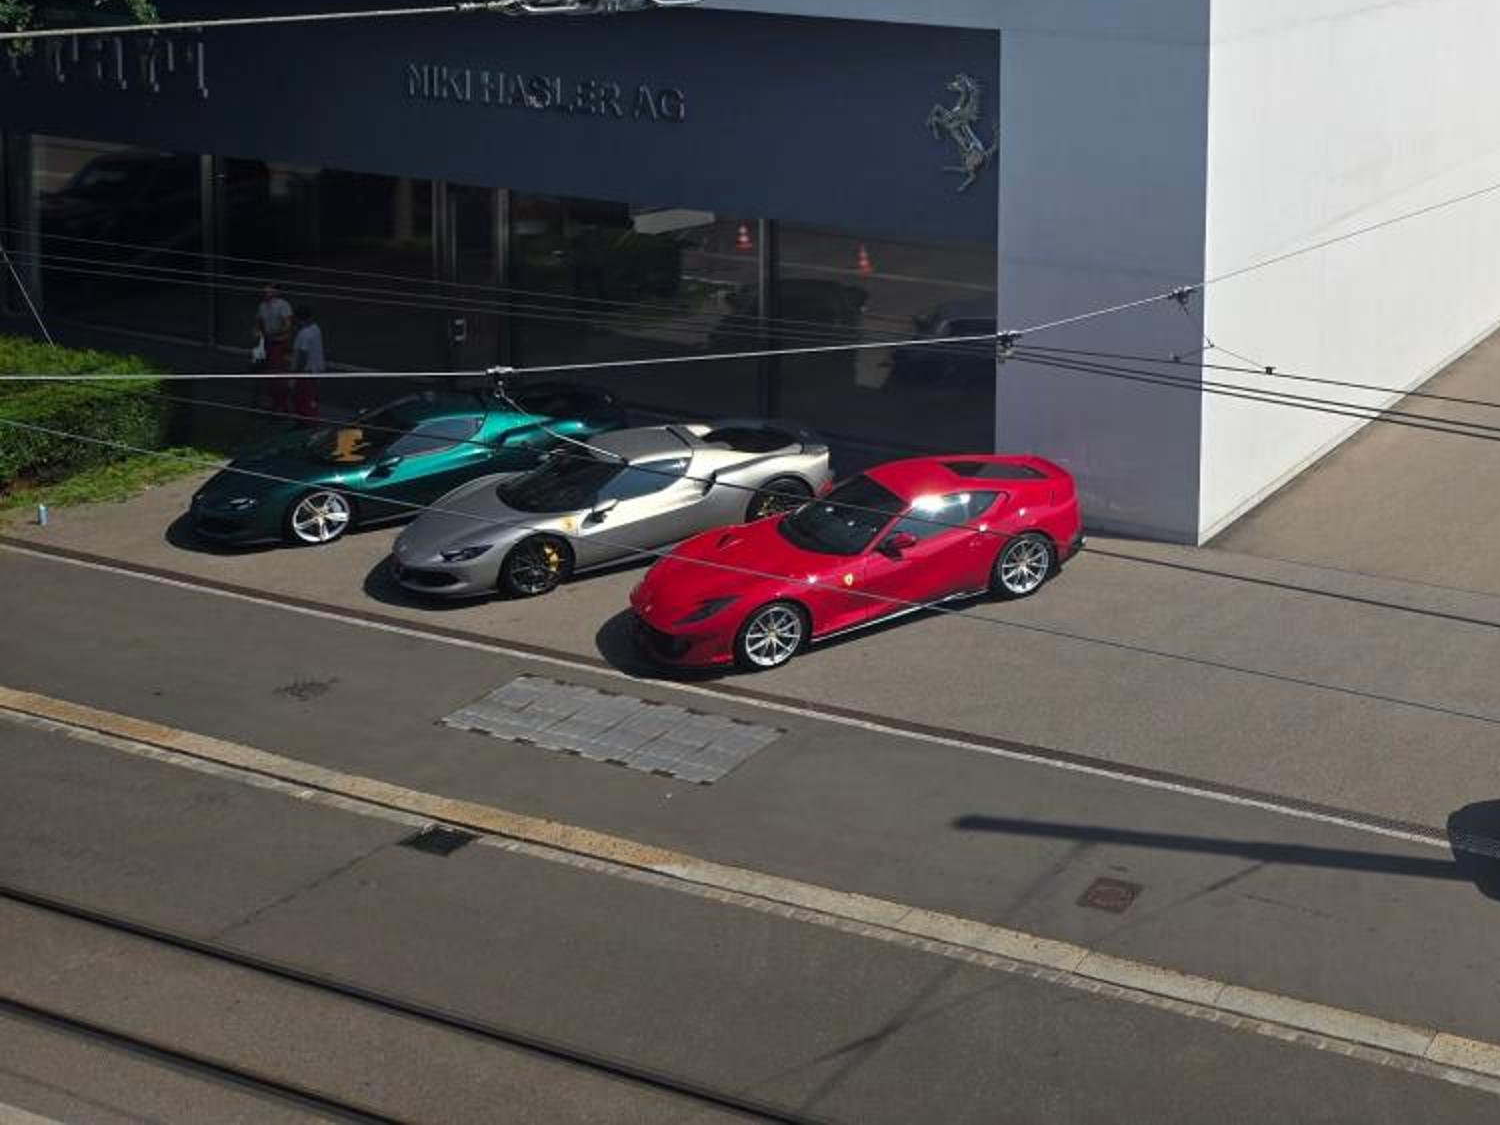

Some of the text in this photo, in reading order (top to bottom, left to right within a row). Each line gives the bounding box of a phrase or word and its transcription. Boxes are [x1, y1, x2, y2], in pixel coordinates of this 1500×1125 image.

[406, 62, 686, 120] NIKI HASLER AG
